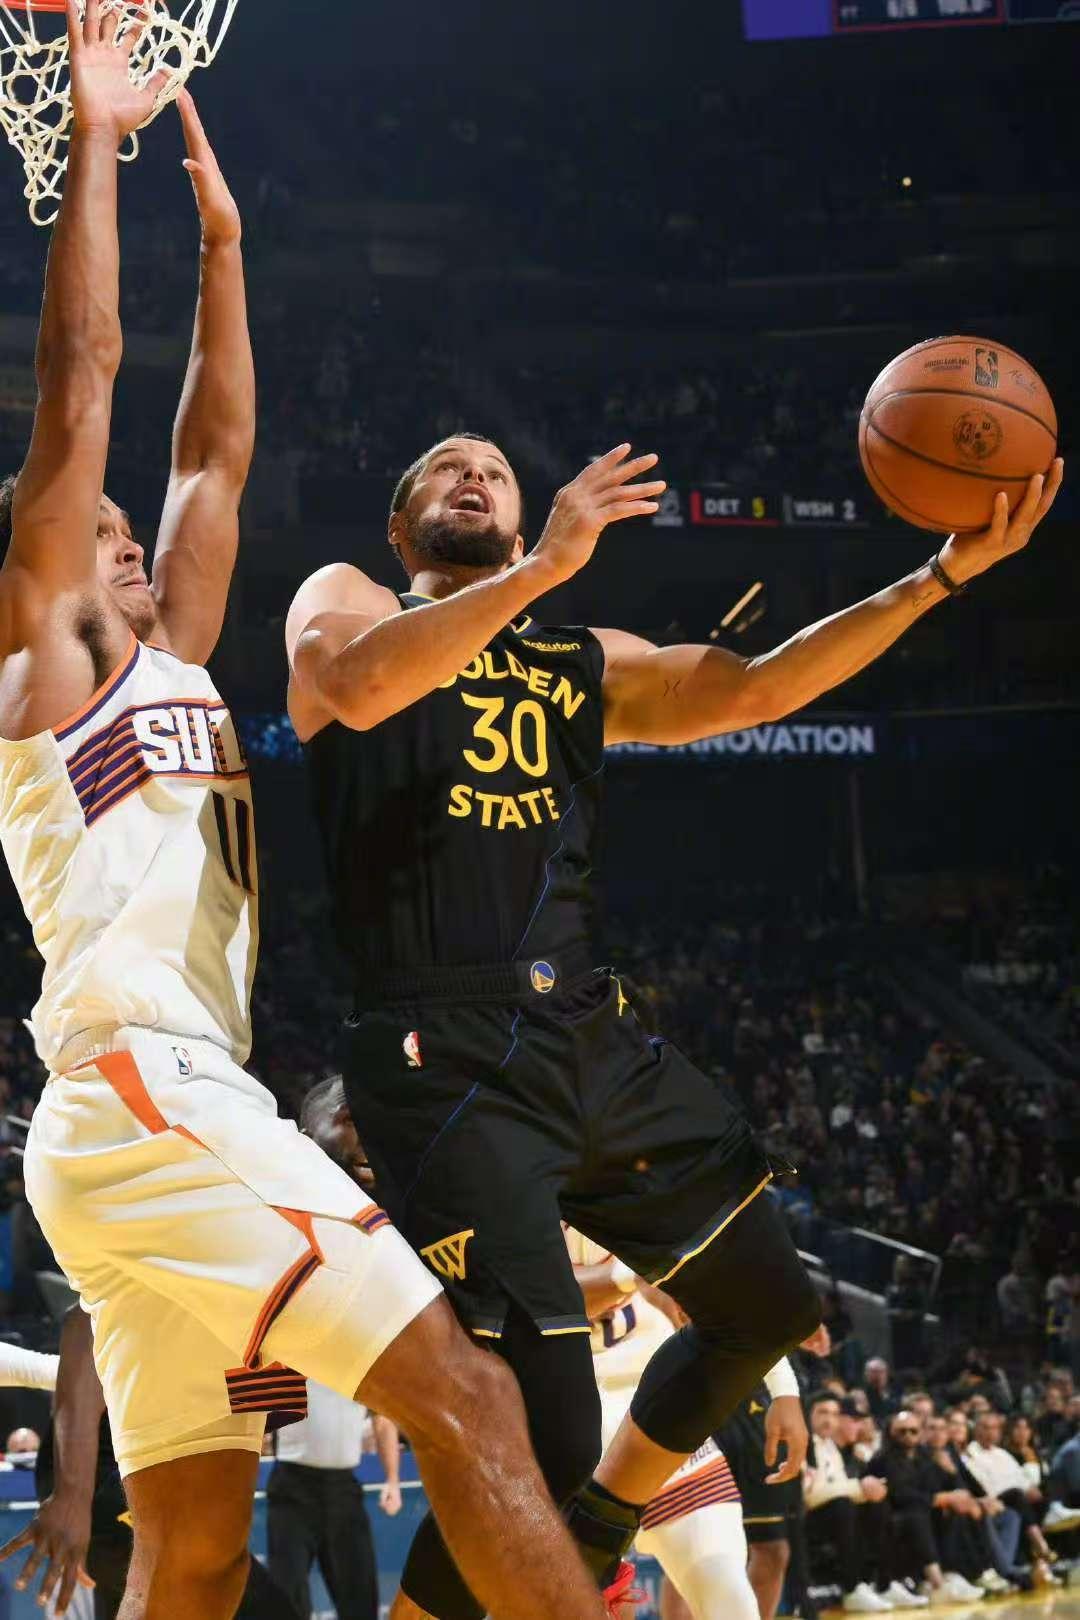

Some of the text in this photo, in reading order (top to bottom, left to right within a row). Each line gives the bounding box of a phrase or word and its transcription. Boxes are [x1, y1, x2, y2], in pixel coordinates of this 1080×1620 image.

[704, 498, 740, 515] DET
[793, 501, 835, 518] WSH
[842, 499, 856, 520] 2
[436, 649, 587, 720] OLDEN
[460, 691, 549, 777] 30
[447, 784, 561, 831] STATE
